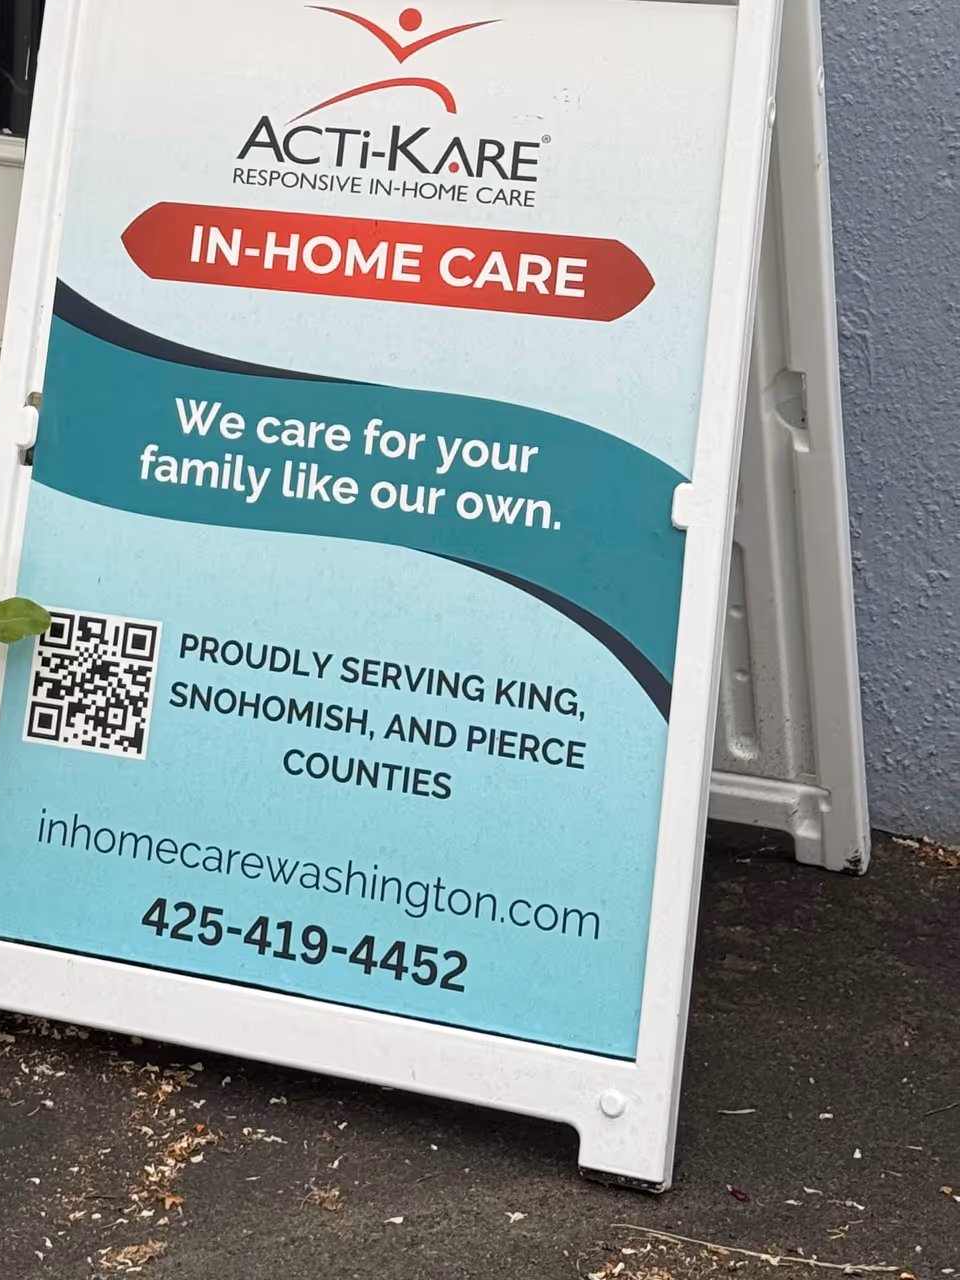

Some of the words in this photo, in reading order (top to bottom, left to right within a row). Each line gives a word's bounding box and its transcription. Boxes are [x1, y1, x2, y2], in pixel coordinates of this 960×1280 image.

[231, 167, 363, 195] RESPONSIVE
[369, 176, 469, 203] IN-HOME
[475, 187, 536, 208] CARE
[189, 224, 423, 284] IN-HOME
[439, 246, 589, 299] CARE
[175, 397, 247, 440] We
[256, 416, 351, 452] care
[363, 418, 427, 461] for
[435, 435, 539, 475] your
[139, 443, 272, 504] family
[281, 459, 359, 505] like
[370, 481, 446, 516] our
[455, 490, 562, 532] own.
[179, 632, 334, 680] PROUDLY
[339, 655, 486, 704] SERVING
[494, 676, 586, 723] KING,
[168, 680, 376, 742] SNOHOMISH,
[382, 712, 458, 749] AND
[465, 724, 588, 770] PIERCE
[282, 748, 453, 801] COUNTIES
[36, 806, 601, 942] inhomecarewashington.com
[140, 896, 469, 994] 425-419-4452
